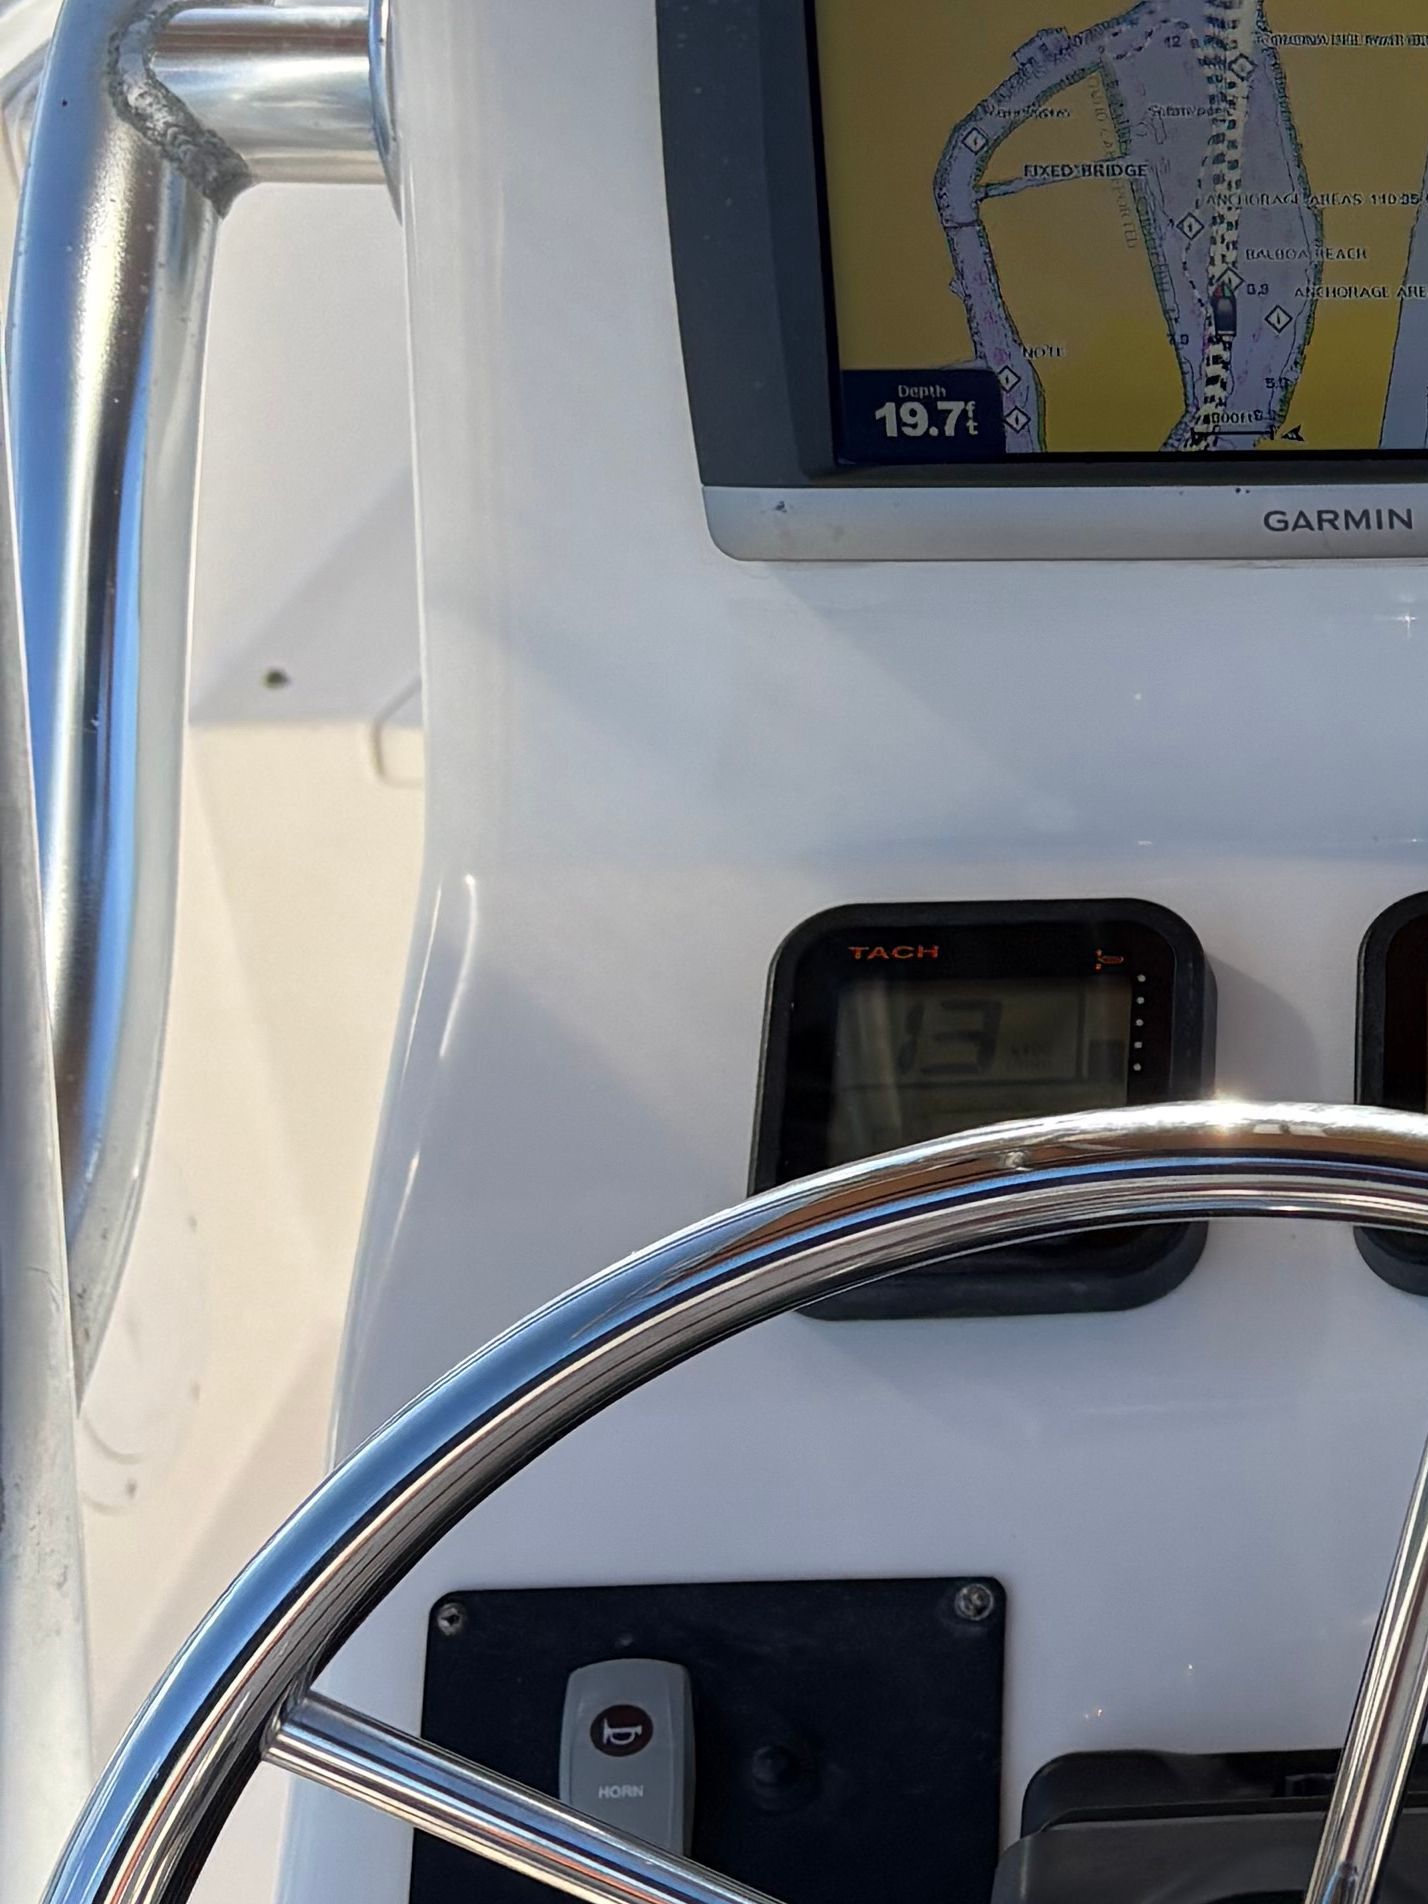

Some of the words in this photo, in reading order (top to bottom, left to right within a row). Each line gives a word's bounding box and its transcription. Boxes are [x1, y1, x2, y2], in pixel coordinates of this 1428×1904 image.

[897, 384, 947, 399] Depth
[1262, 507, 1414, 534] GARMIN
[848, 944, 940, 960] TACH
[598, 1784, 645, 1799] HORN
